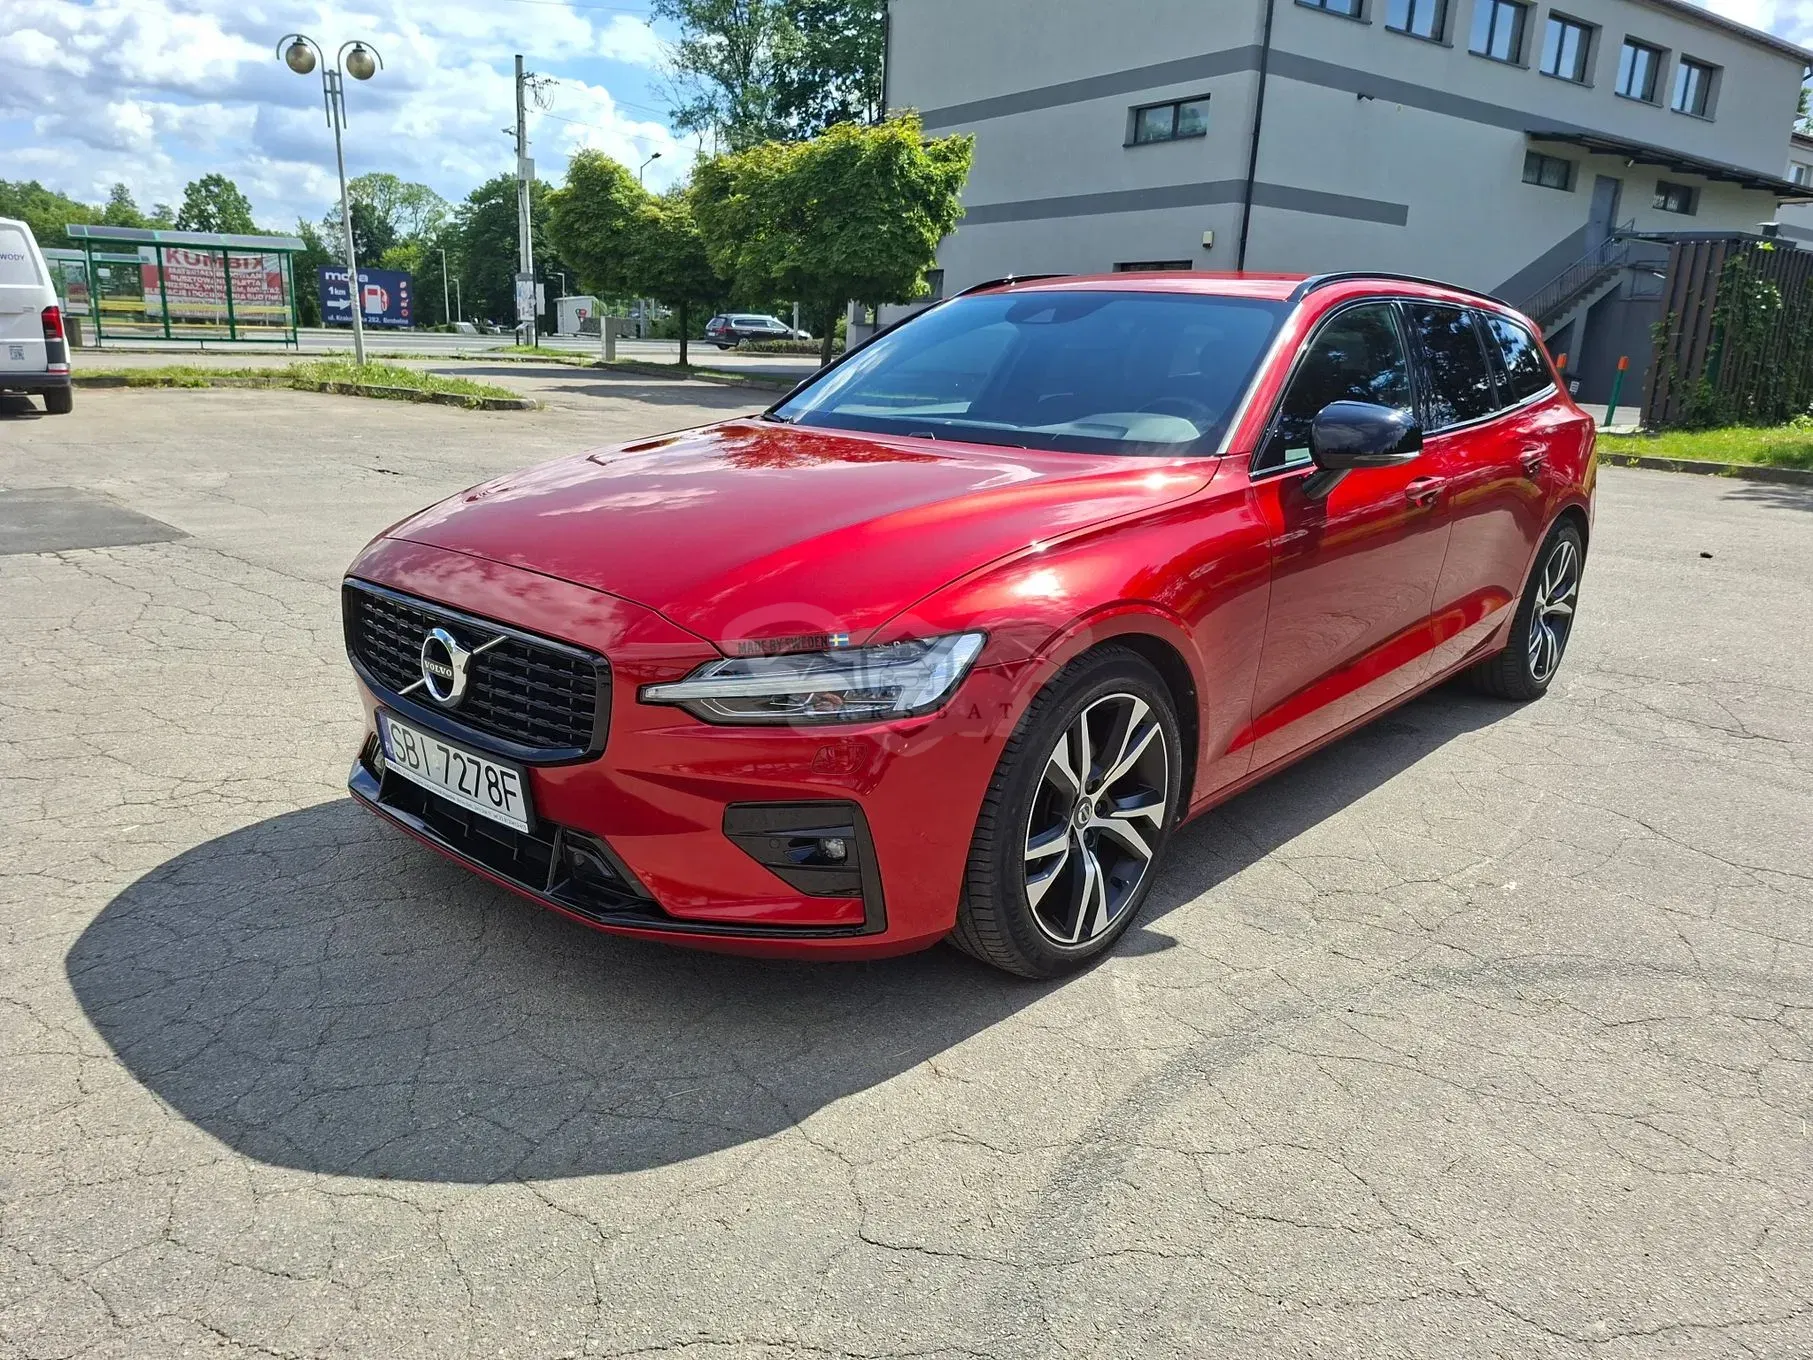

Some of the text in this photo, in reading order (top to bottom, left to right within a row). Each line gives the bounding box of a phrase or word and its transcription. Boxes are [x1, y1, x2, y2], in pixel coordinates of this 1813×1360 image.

[325, 271, 369, 283] moa
[334, 287, 346, 296] km
[783, 634, 828, 652] SWEDEN
[424, 660, 453, 677] VOLVO
[436, 745, 517, 812] 7278F
